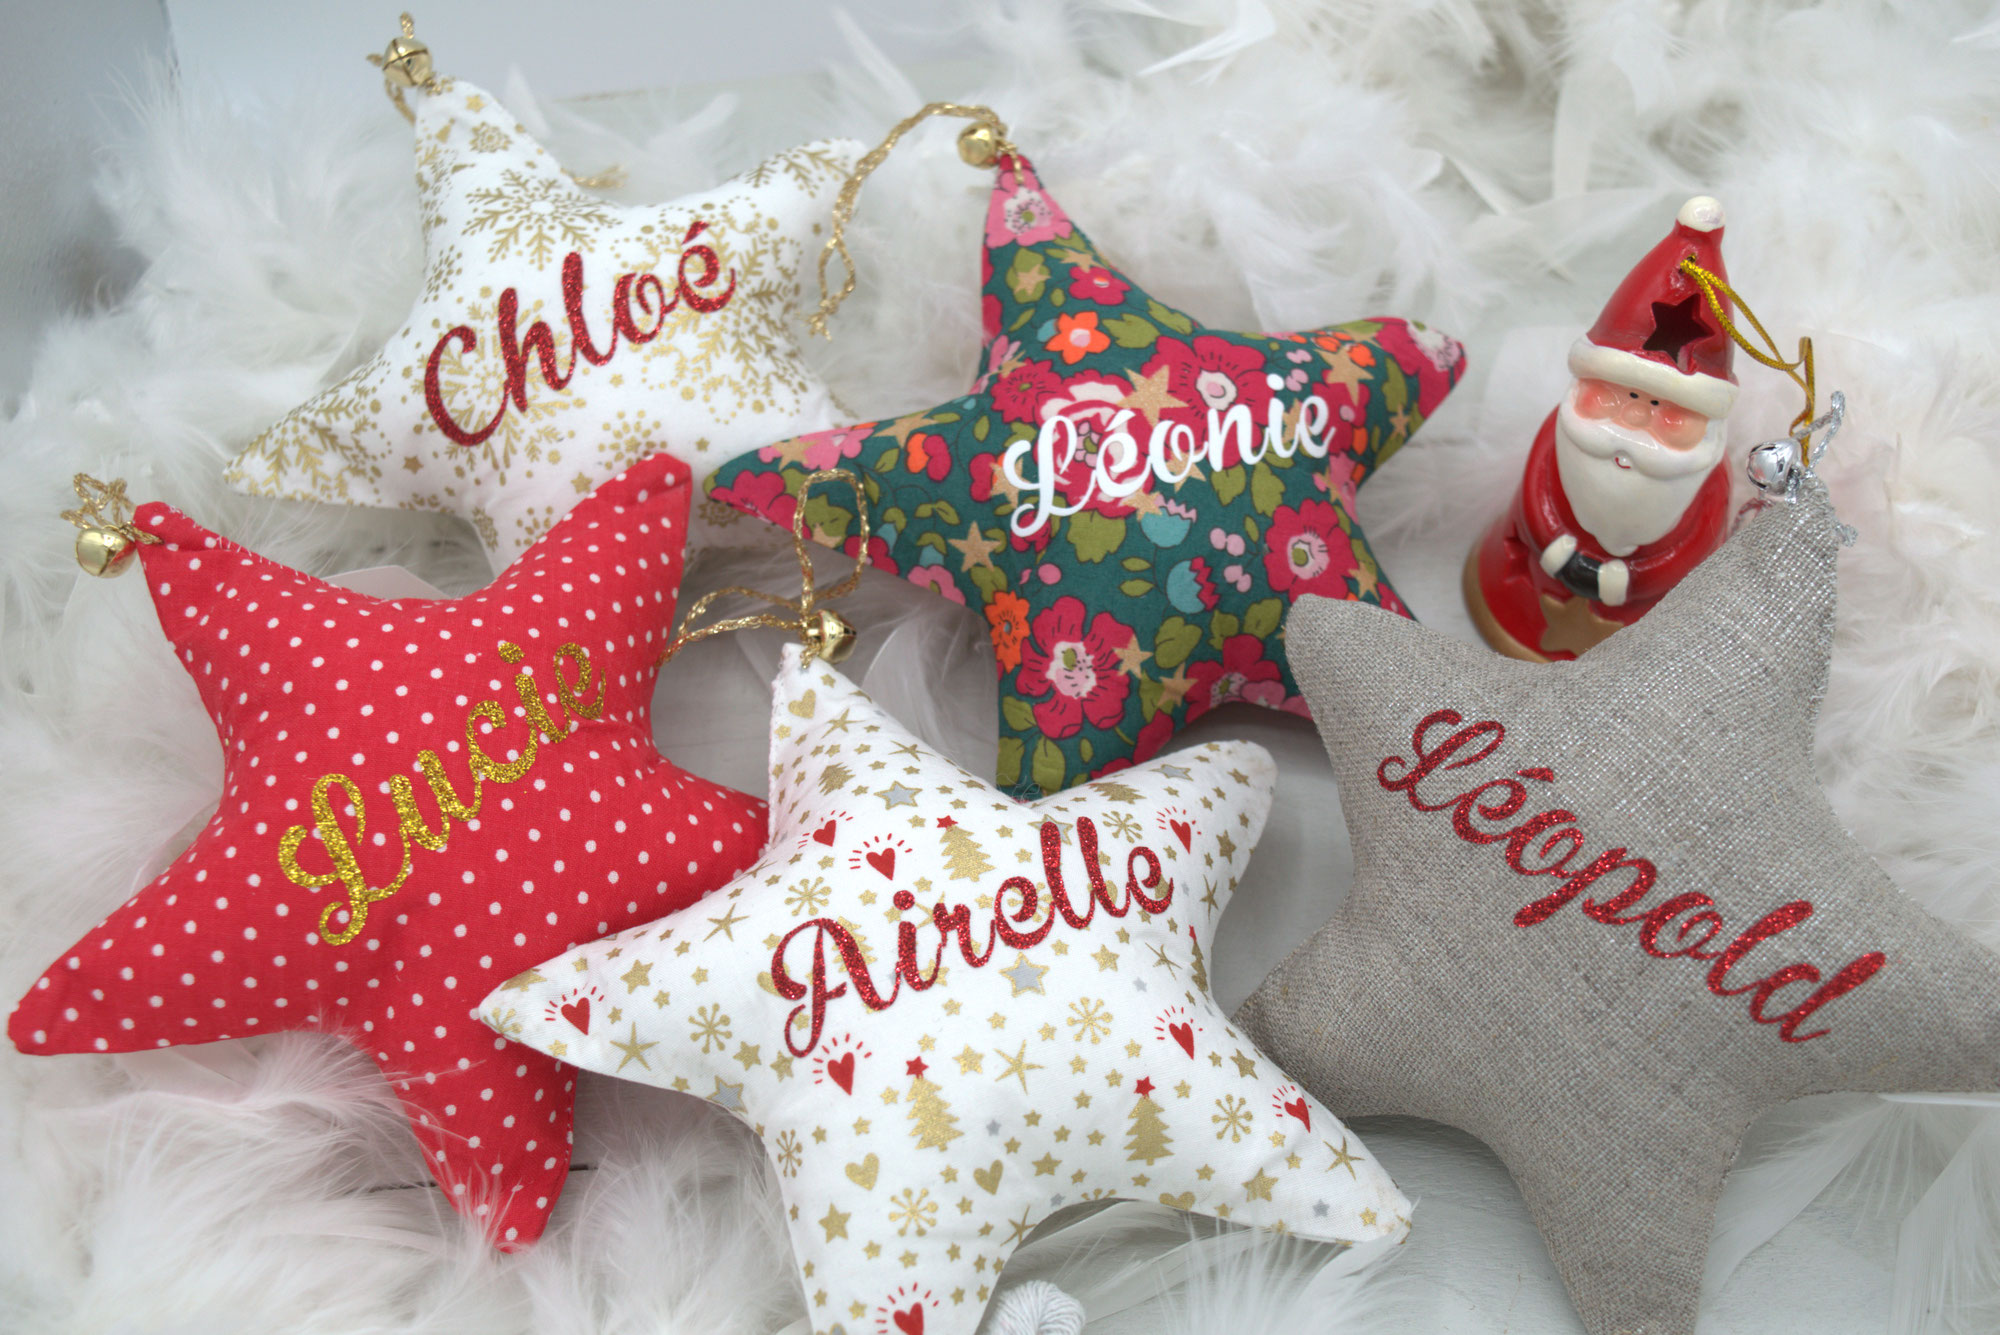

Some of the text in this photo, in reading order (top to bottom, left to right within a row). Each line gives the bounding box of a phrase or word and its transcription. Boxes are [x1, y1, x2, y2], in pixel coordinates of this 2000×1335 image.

[424, 221, 736, 446] Chloé
[1003, 373, 1336, 537] Léonie
[278, 642, 606, 946] Lucie
[1377, 709, 1886, 1043] Léopold
[771, 816, 1174, 1058] Airelle
